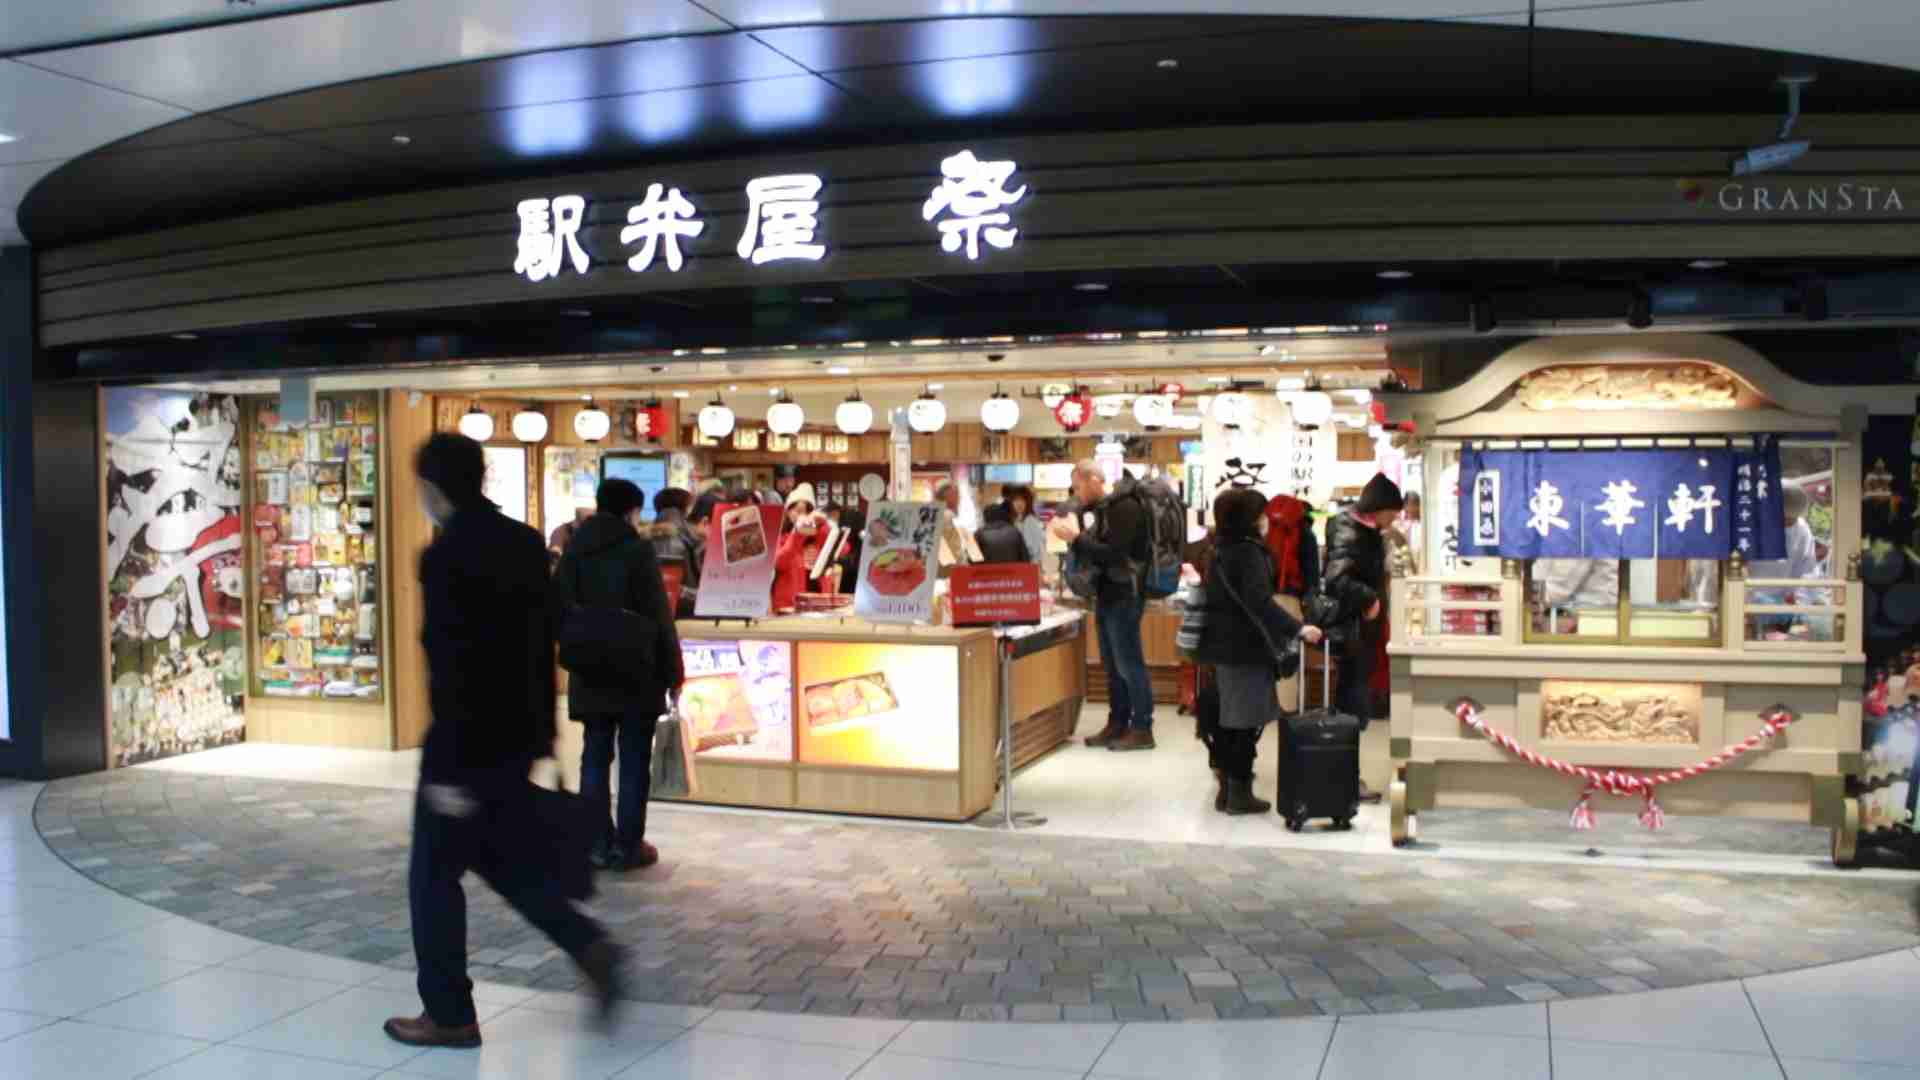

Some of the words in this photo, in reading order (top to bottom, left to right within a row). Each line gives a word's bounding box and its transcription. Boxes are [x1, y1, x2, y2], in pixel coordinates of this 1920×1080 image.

[513, 173, 827, 282] 駅弁屋
[922, 149, 1028, 261] 祭
[1718, 183, 1904, 211] GRANSTA
[1525, 479, 1722, 537] 東華軒
